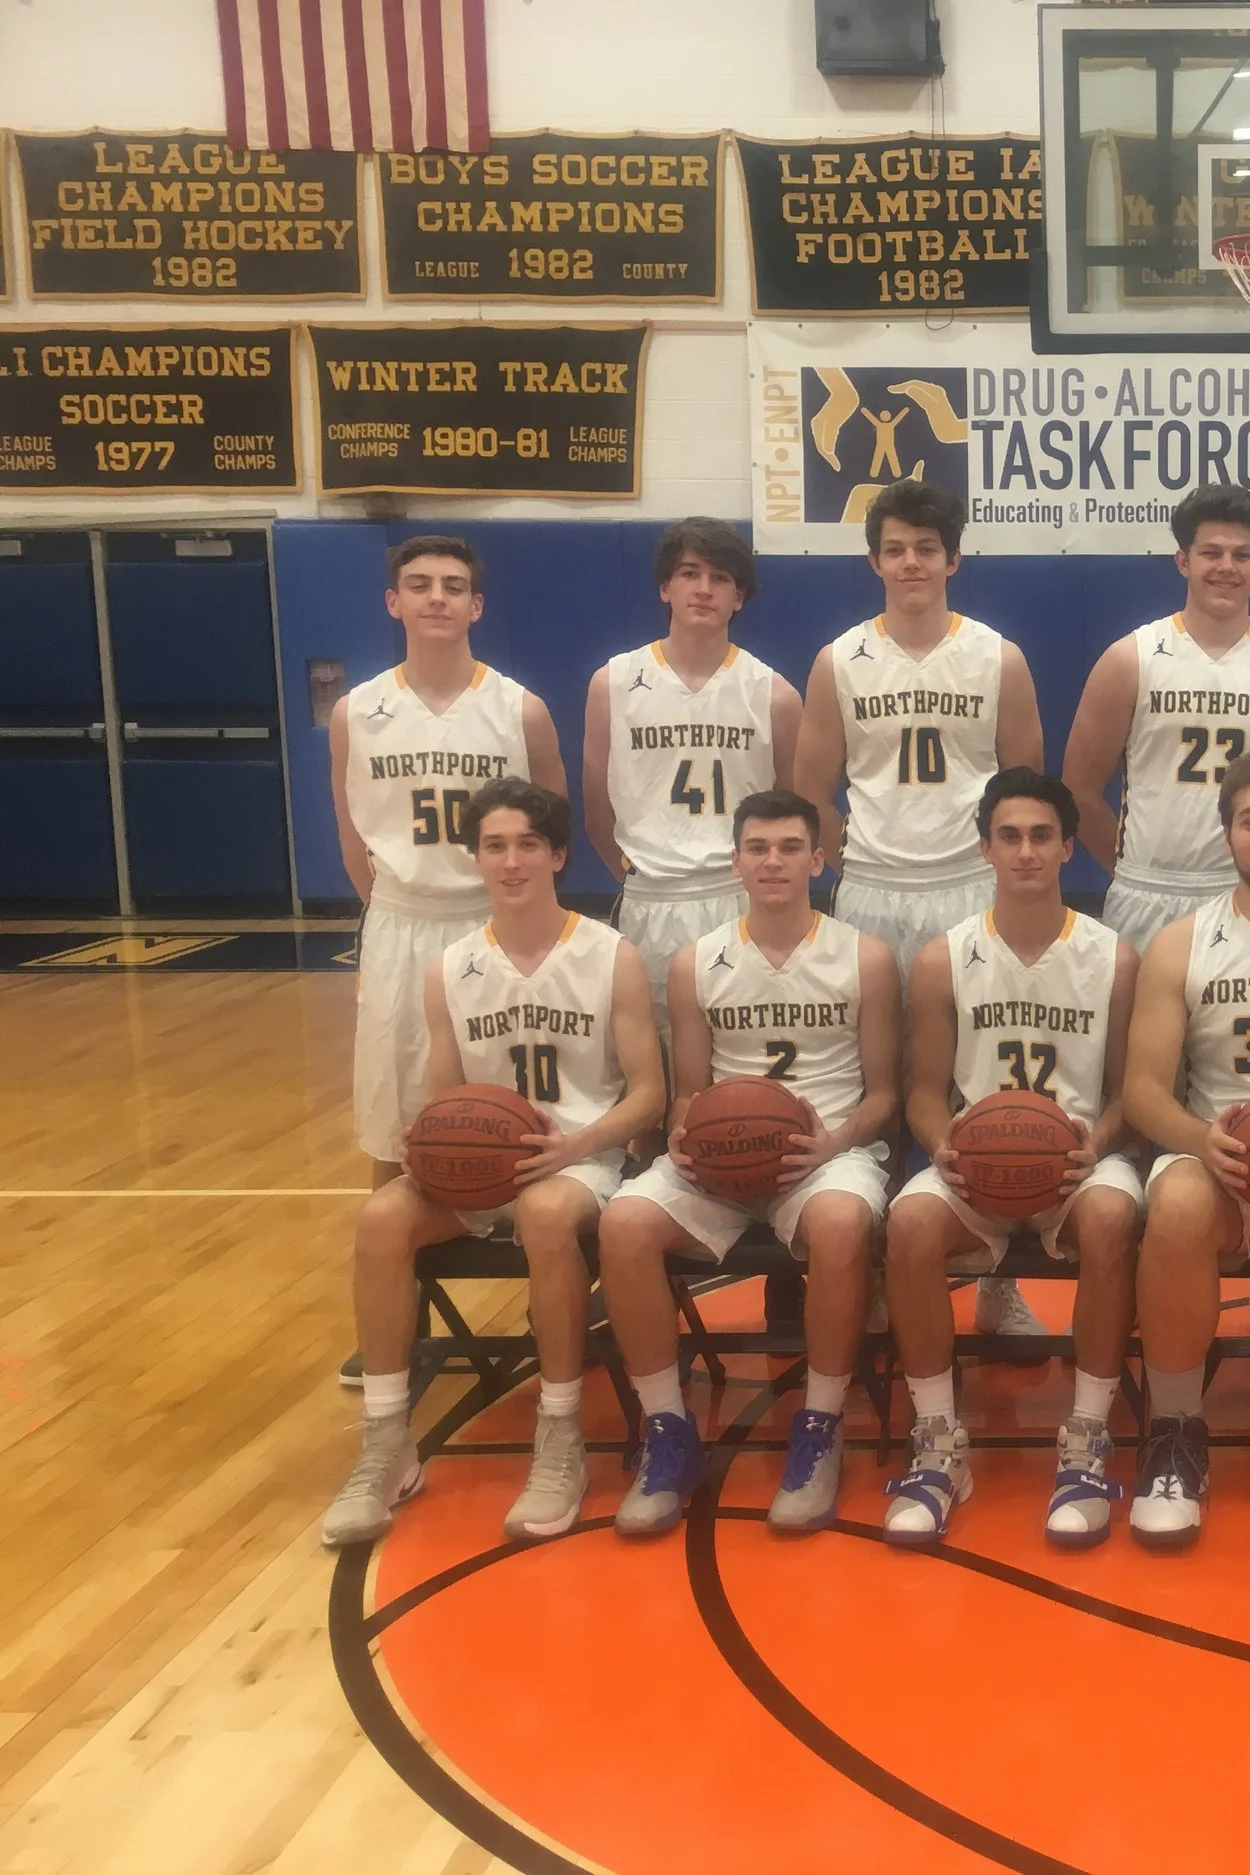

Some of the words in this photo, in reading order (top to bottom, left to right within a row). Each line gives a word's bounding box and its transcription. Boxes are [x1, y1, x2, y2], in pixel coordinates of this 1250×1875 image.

[93, 142, 286, 174] LEAGUE
[388, 152, 509, 185] BOYS
[532, 154, 709, 187] SOCCER
[778, 148, 974, 184] LEAGUE
[57, 181, 324, 213] CHAMPIONS
[417, 201, 684, 233] CHAMPIONS
[32, 218, 163, 249] FIELD
[182, 219, 353, 251] HOCKEY
[152, 256, 237, 287] 1982
[415, 260, 480, 278] LEAGUE
[508, 248, 594, 280] 1982
[622, 262, 689, 280] COUNTY
[878, 268, 965, 302] 1982
[41, 345, 271, 377] CHAMPIONS
[326, 361, 477, 392] WINTER
[499, 362, 628, 394] TRACK
[60, 394, 205, 425] SOCCER
[762, 365, 800, 444] ENPT
[213, 435, 275, 451] COUNTY
[328, 423, 410, 440] CONFERENCE
[422, 427, 550, 459] 1980-81
[570, 426, 627, 444] LEAGUE
[95, 441, 175, 471] 1977
[214, 454, 276, 470] CHAMPS
[340, 442, 398, 459] CHAMPS
[568, 445, 627, 463] CHAMPS
[765, 464, 801, 523] NPT
[972, 498, 1063, 529] Educating
[1068, 501, 1080, 523] &
[853, 690, 984, 721] NORTHPORT
[630, 724, 755, 751] NORTHPORT
[369, 751, 508, 780] NORTHPORT
[898, 727, 946, 783] 10
[1177, 726, 1245, 784] 23
[671, 759, 726, 815] 41
[411, 787, 470, 846] 50
[466, 1003, 595, 1042] NORTHPORT
[707, 1002, 848, 1031] NORTHPORT
[971, 1000, 1094, 1035] NORTHPORT
[509, 1044, 561, 1102] 10
[764, 1040, 797, 1080] 2
[997, 1040, 1056, 1102] 32
[420, 1115, 511, 1142] SPALDING
[968, 1123, 1056, 1147] SPALDING
[698, 1130, 783, 1160] SPALDING
